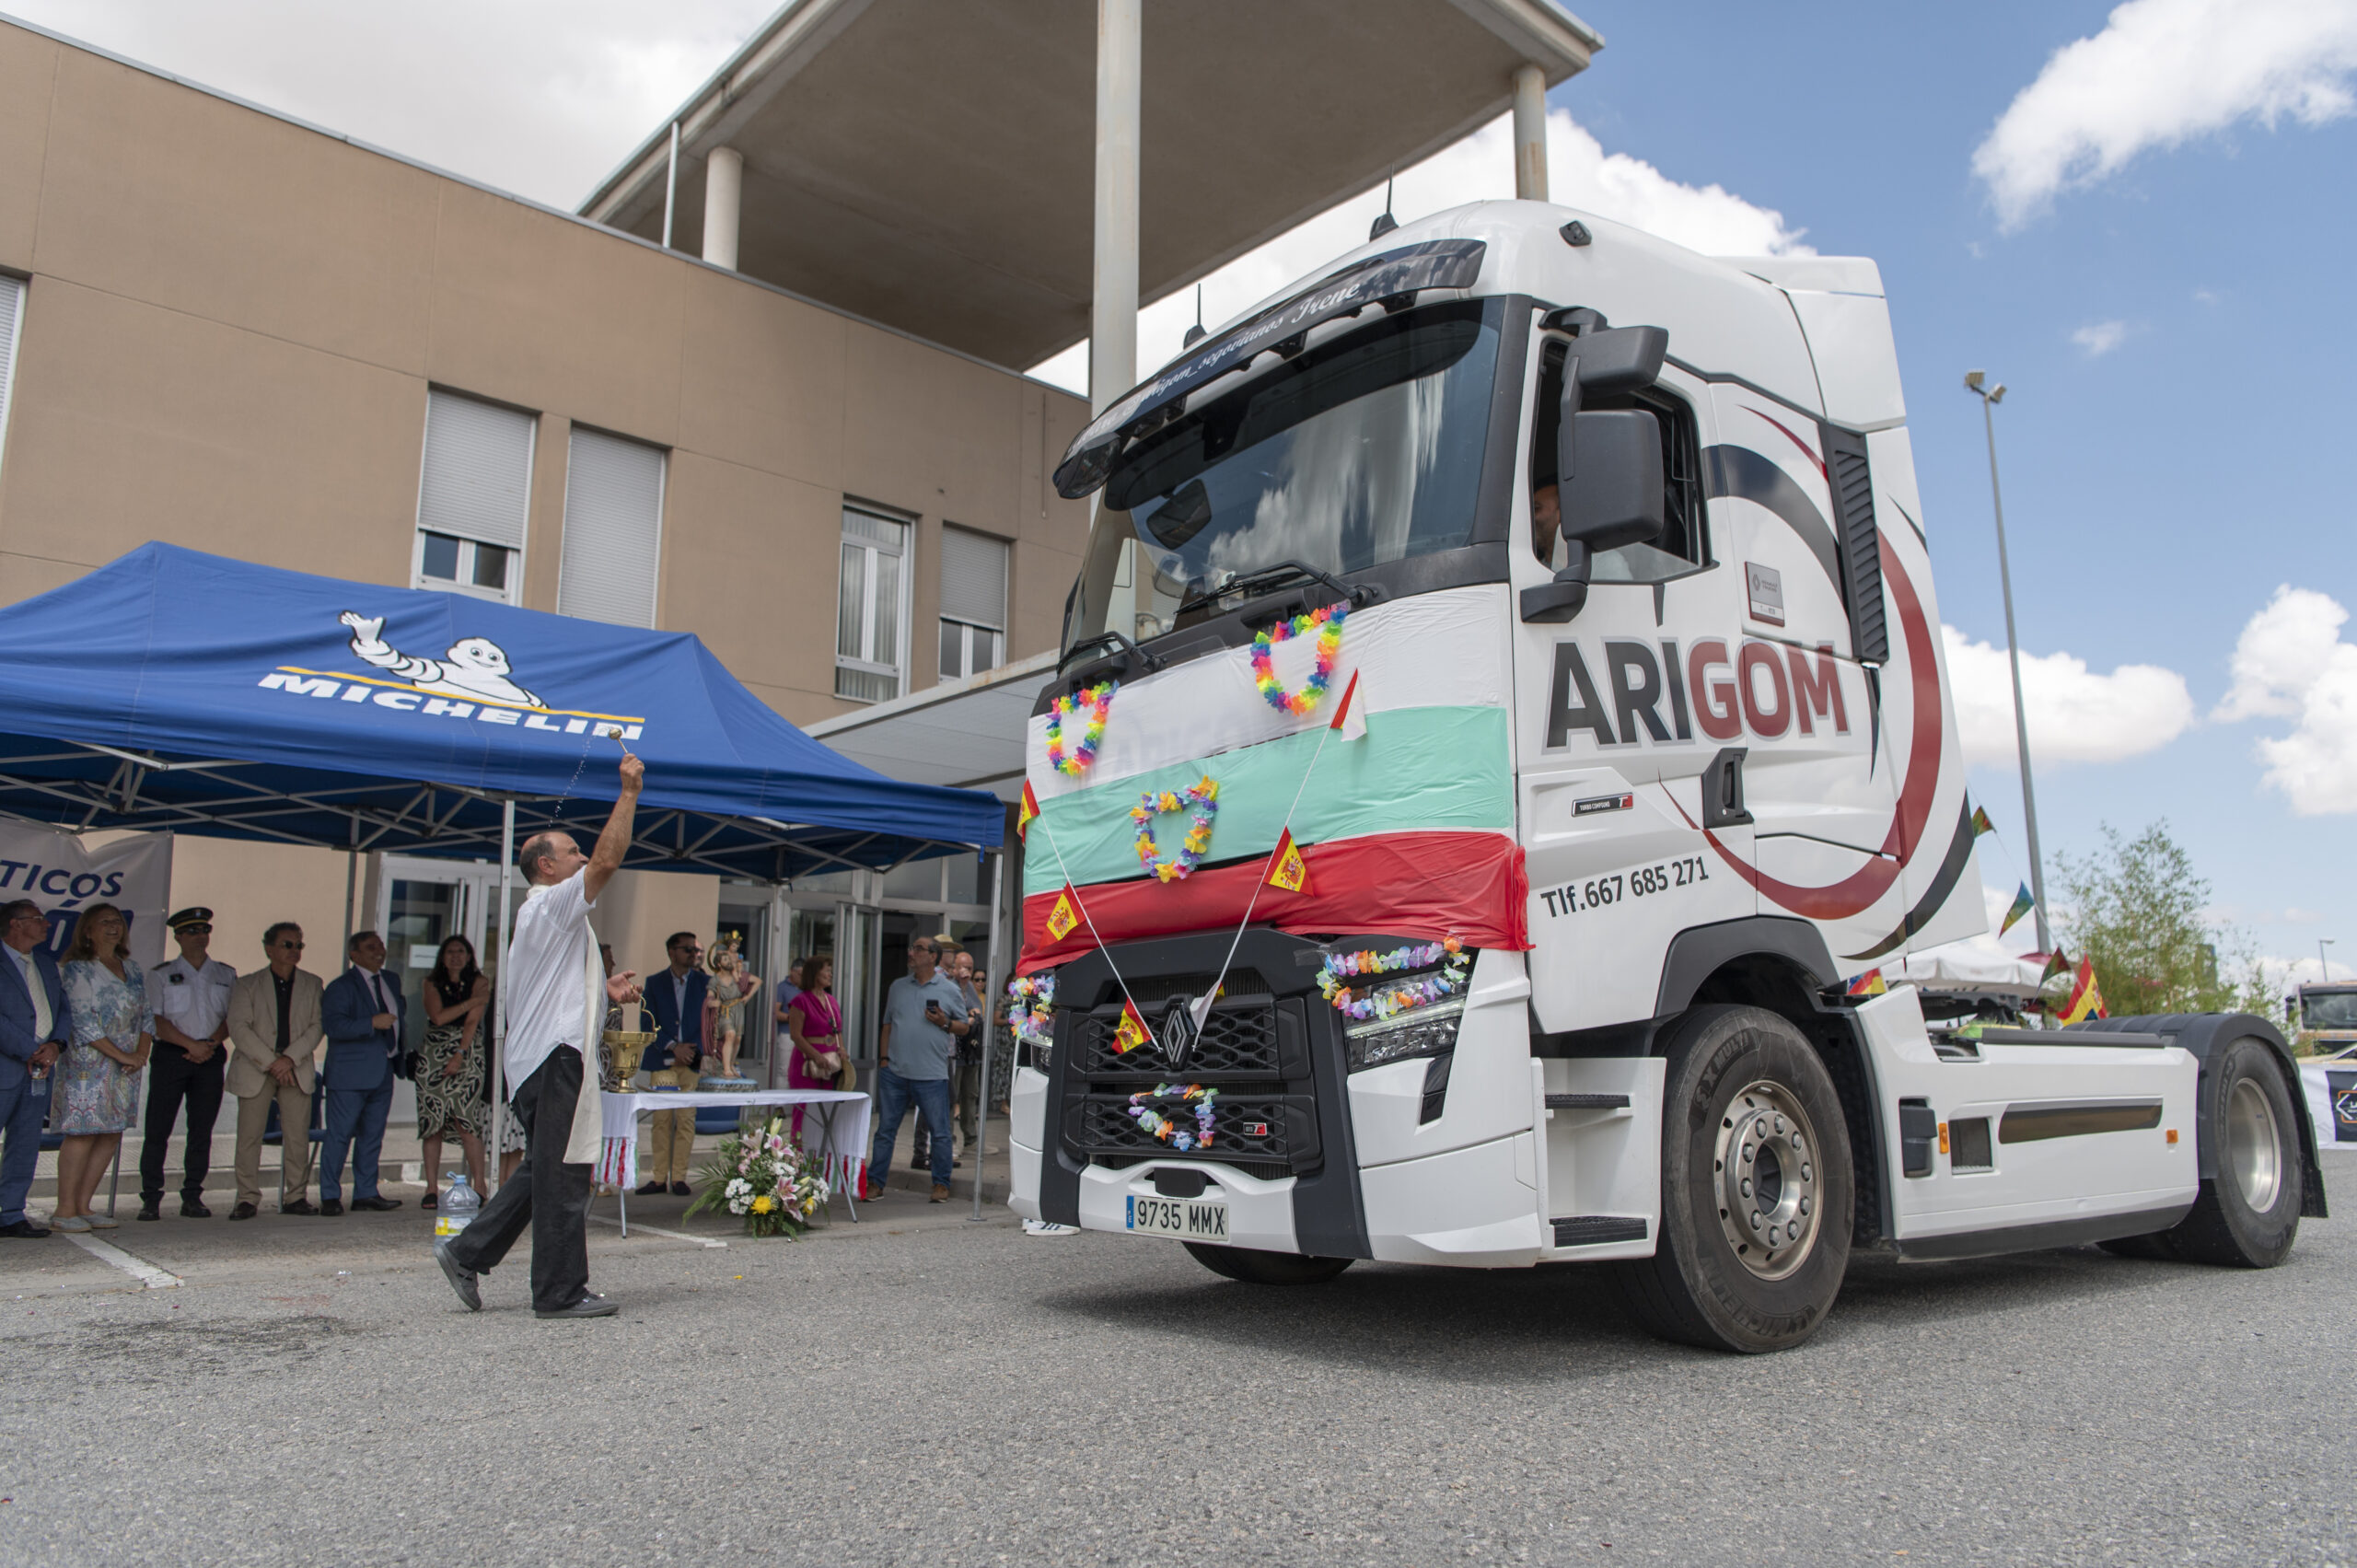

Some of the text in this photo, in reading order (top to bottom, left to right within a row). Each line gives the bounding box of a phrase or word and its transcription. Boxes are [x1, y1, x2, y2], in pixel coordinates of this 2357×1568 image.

[1291, 283, 1361, 324] Irene
[257, 673, 644, 740] MICHELIN
[1542, 636, 1852, 754] ARIGOM
[0, 860, 124, 899] TICOS
[1631, 865, 1668, 897] 685
[1672, 856, 1710, 887] 271
[1138, 1200, 1181, 1230] 9735
[1189, 1204, 1225, 1235] MMX
